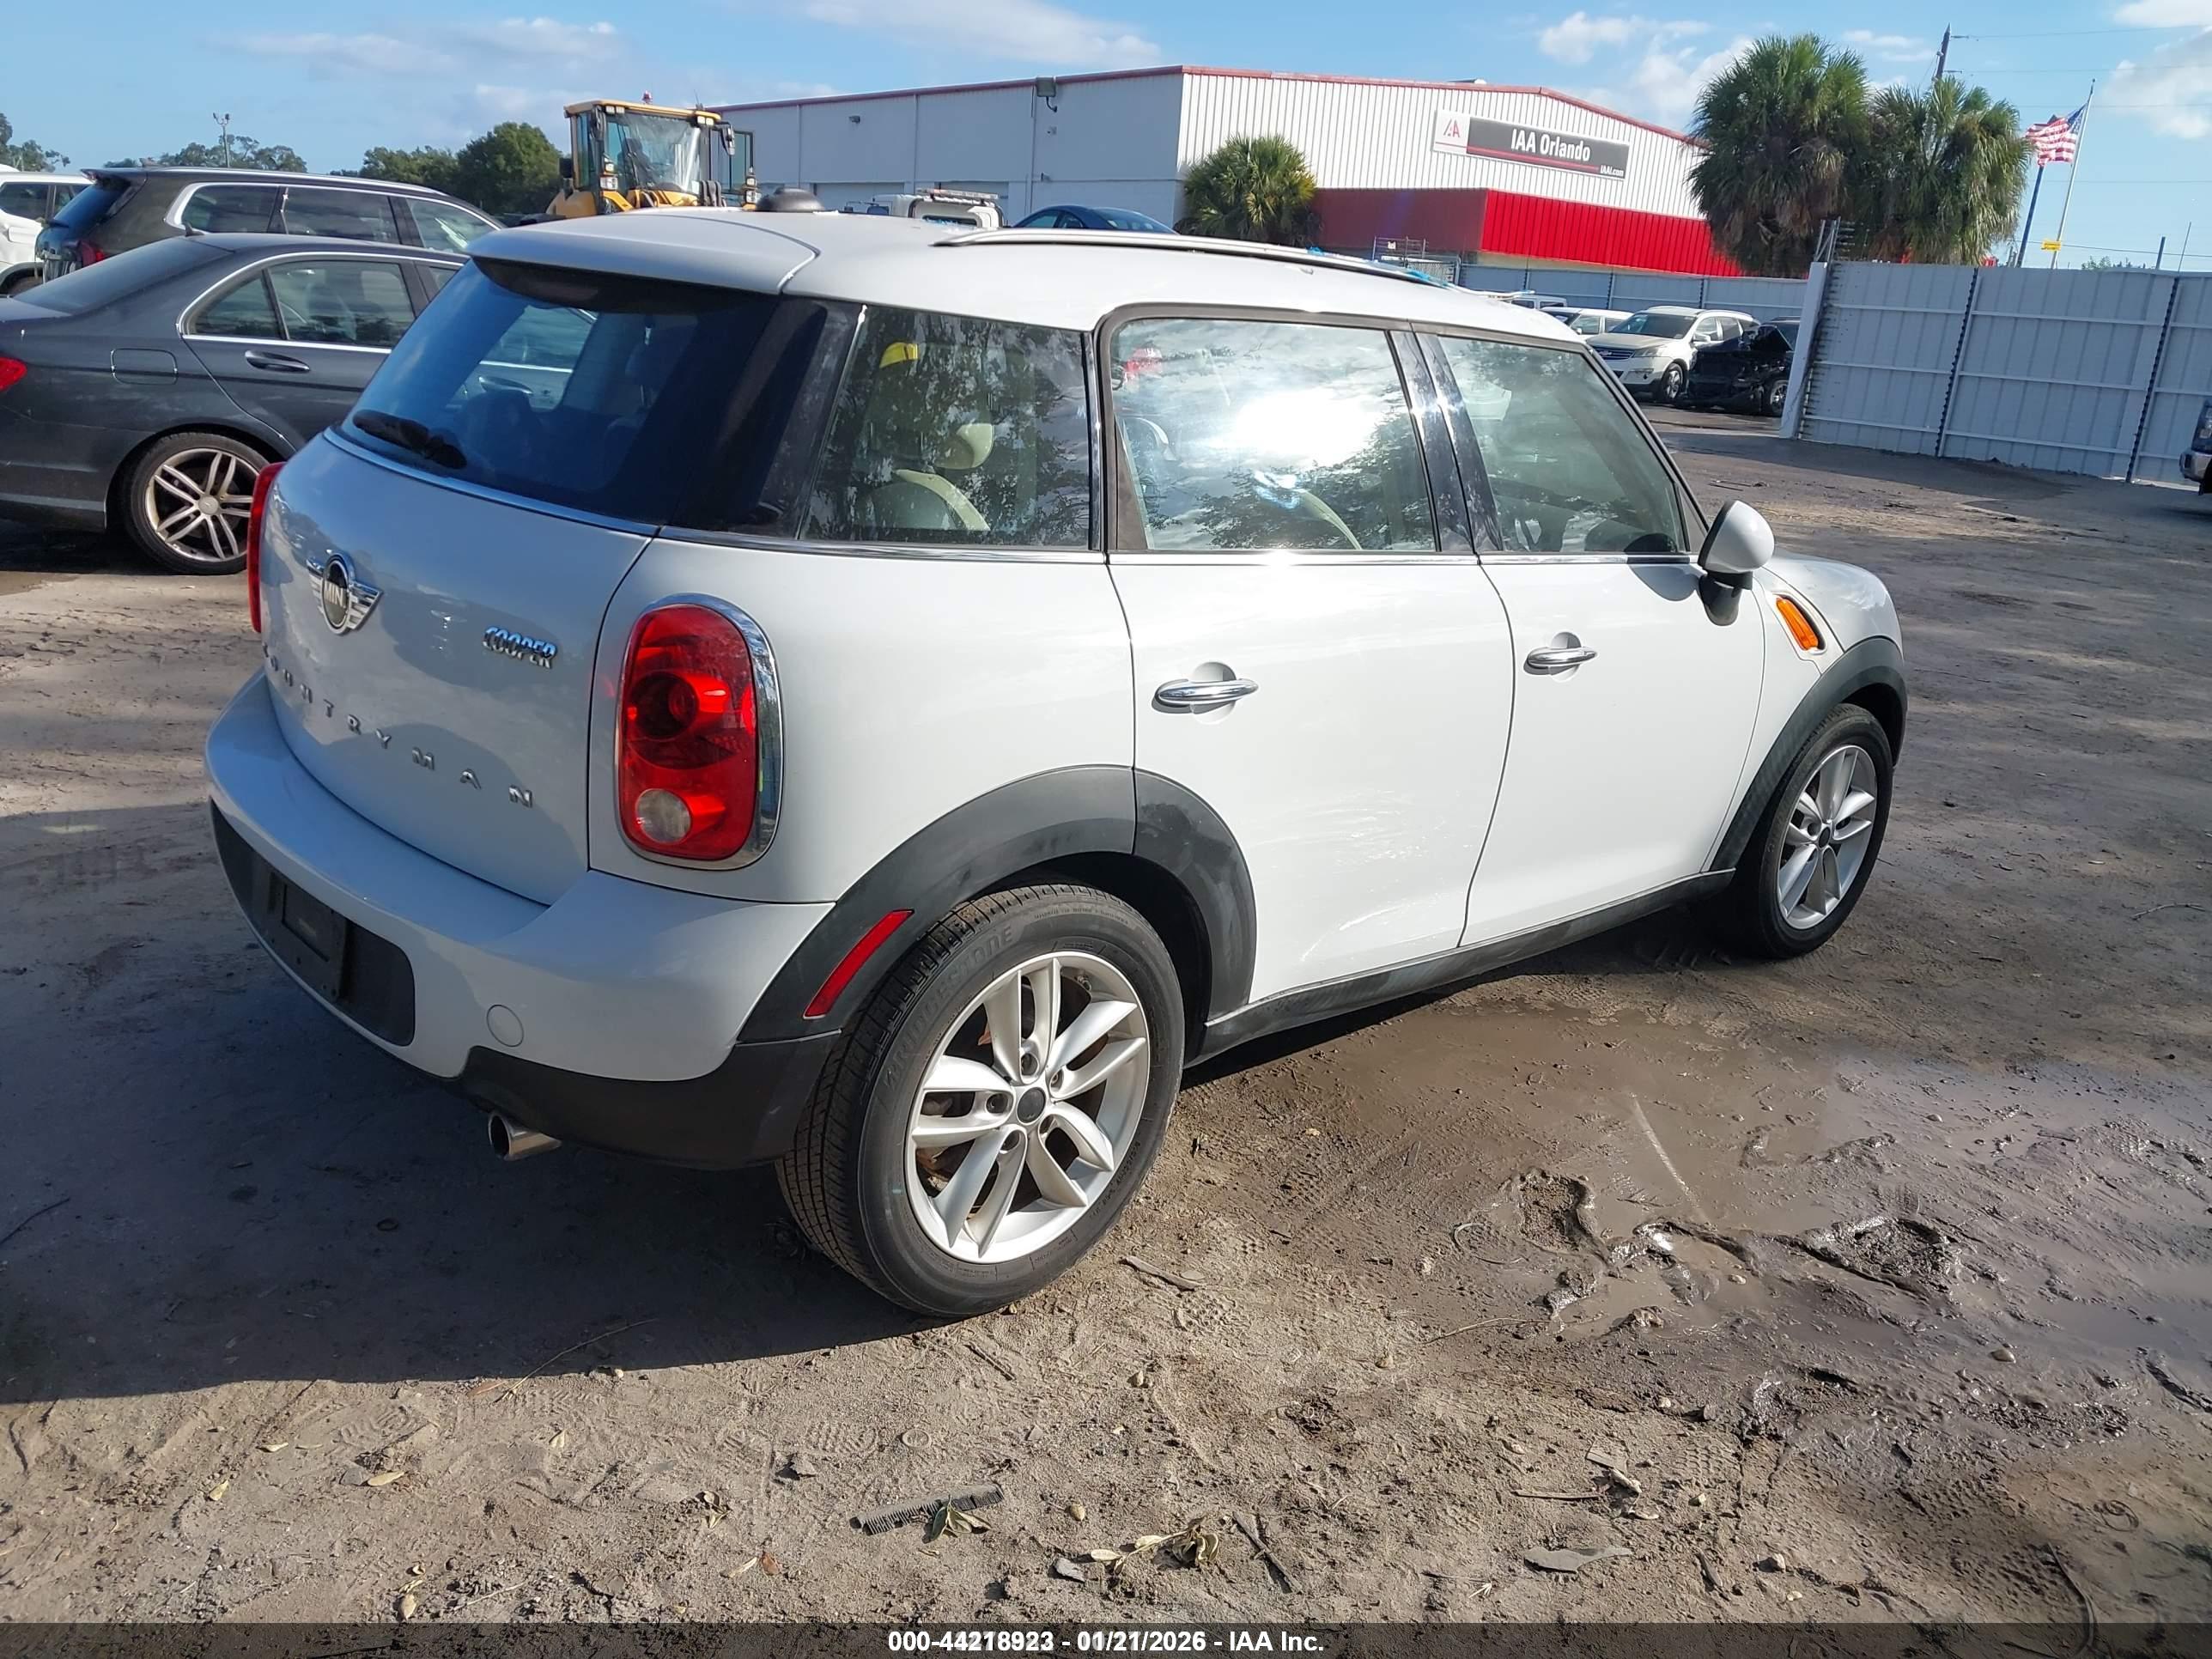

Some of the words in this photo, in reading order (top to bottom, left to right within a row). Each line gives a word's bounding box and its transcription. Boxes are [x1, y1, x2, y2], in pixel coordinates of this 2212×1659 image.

[1511, 128, 1536, 153] IAA
[1540, 133, 1591, 161] Orlando
[483, 626, 557, 669] COOPER
[261, 641, 534, 809] COUNTRYMAN
